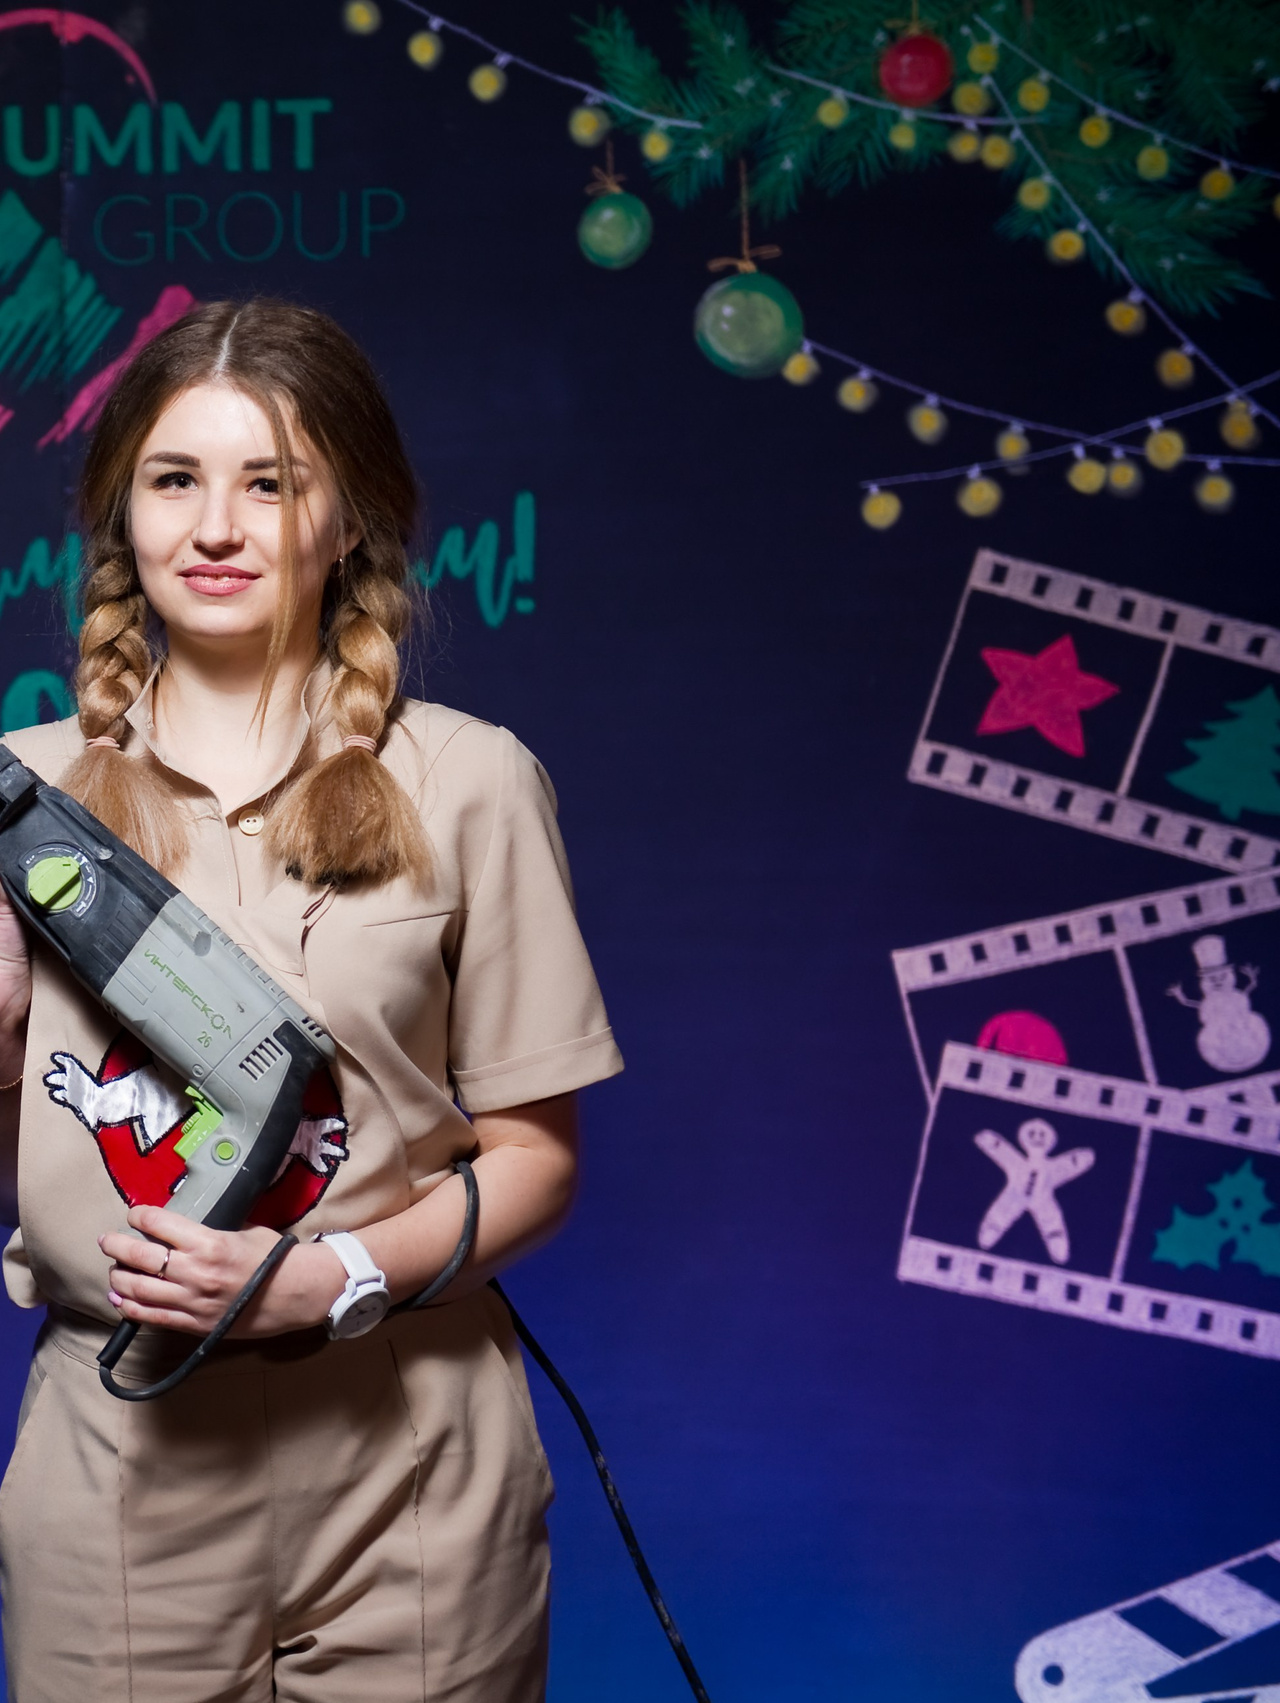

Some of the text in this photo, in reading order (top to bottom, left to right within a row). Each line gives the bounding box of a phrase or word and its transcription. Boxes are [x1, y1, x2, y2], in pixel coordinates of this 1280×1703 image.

[93, 188, 405, 266] GROUP
[144, 949, 232, 1040] ИНТЕРСКОЛ
[197, 1031, 212, 1048] 26
